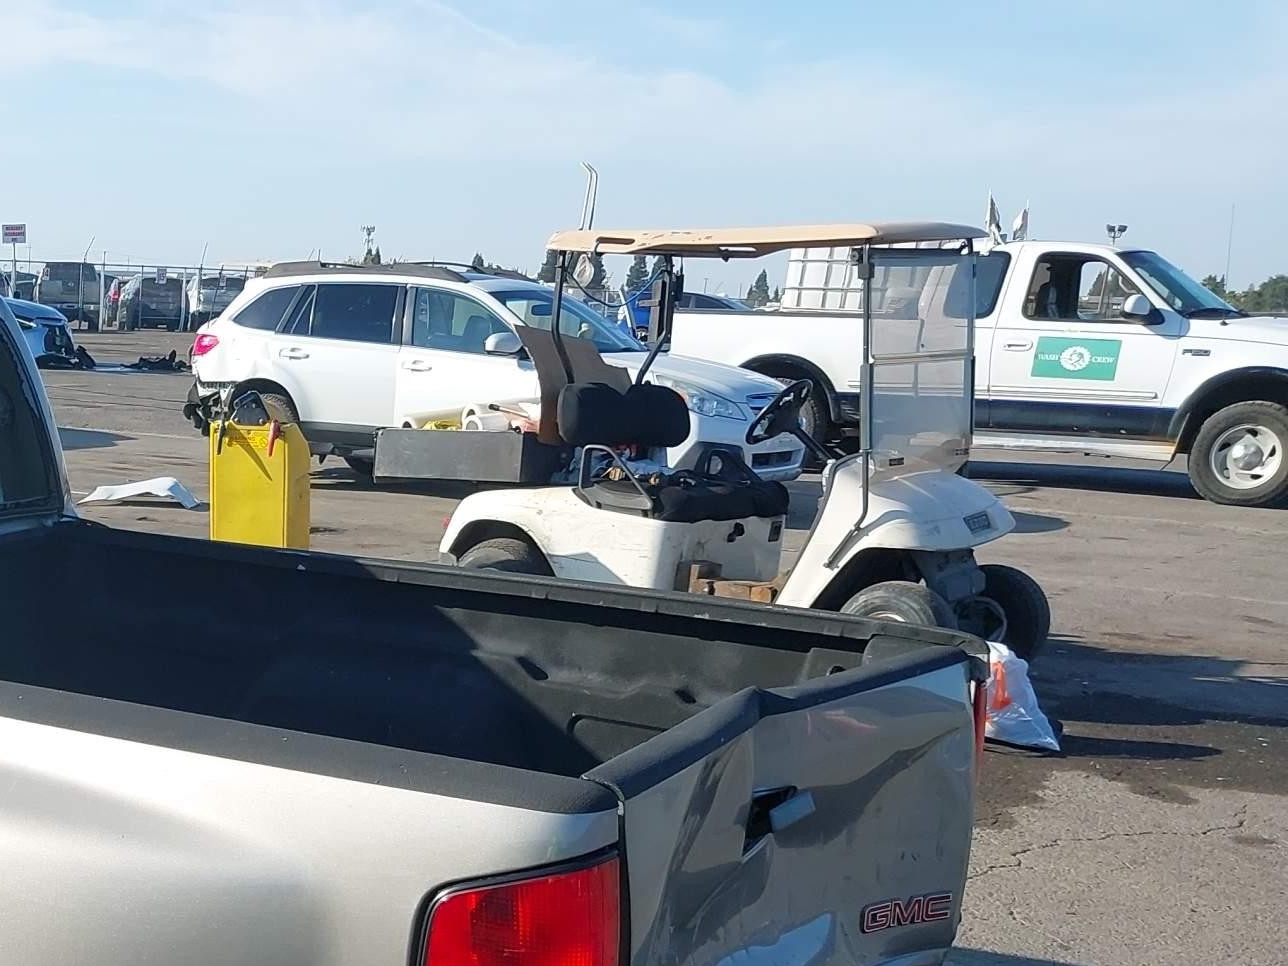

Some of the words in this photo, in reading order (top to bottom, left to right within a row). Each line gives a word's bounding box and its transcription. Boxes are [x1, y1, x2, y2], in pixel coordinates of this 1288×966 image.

[1037, 352, 1060, 361] WASH
[1091, 355, 1116, 364] CREW
[862, 892, 953, 933] GMC
